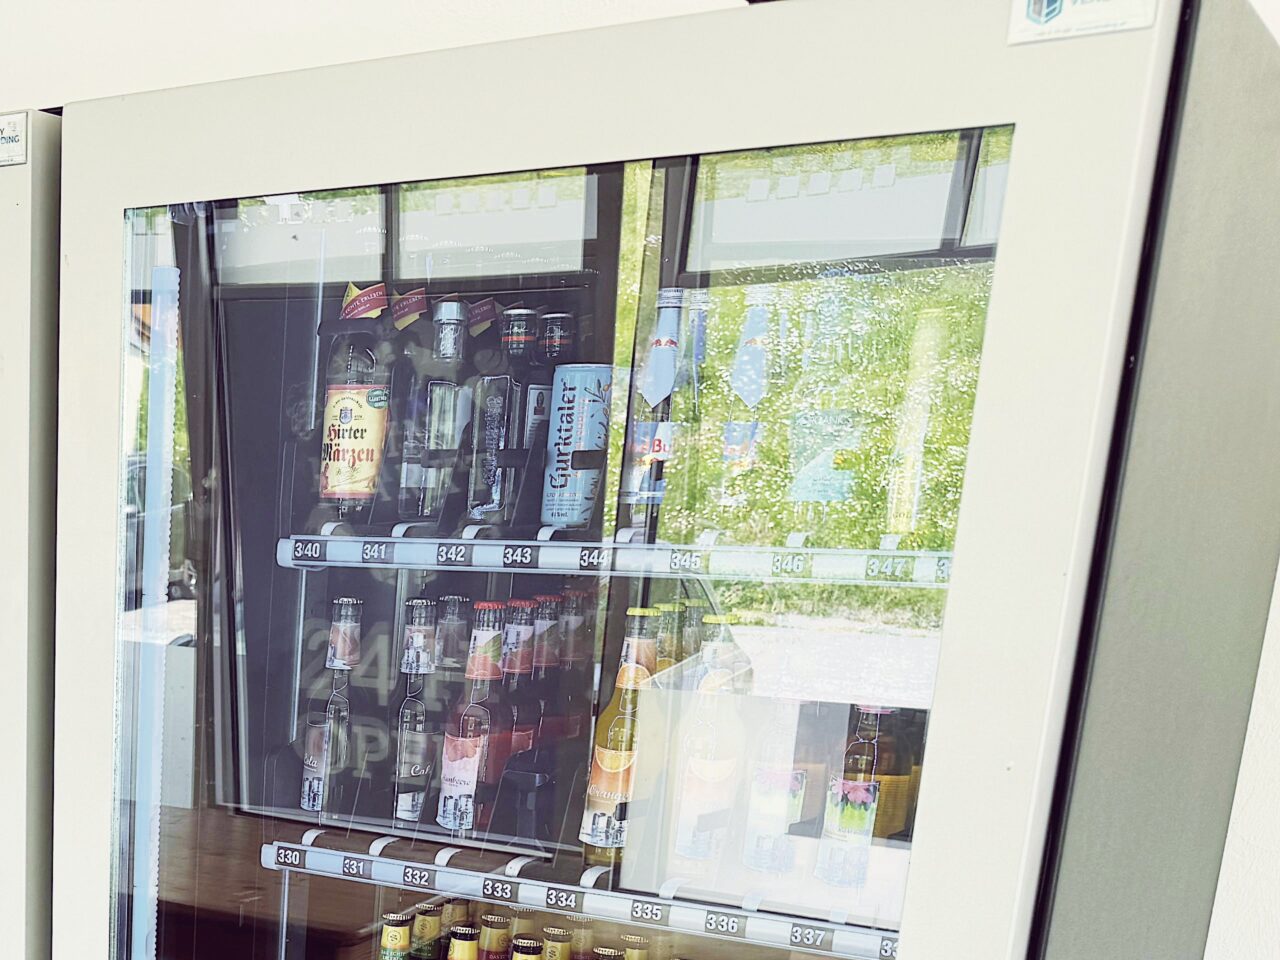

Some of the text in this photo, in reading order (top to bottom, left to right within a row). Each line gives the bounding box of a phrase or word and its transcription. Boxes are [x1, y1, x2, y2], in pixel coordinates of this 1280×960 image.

[327, 423, 367, 441] Hirter
[549, 381, 577, 489] Gurktaler
[322, 442, 374, 468] Märzen
[294, 542, 320, 558] 340
[363, 543, 386, 560] 341
[438, 544, 465, 561] 342
[504, 547, 531, 564] 343
[580, 549, 608, 566] 344
[671, 552, 701, 571] 345
[772, 554, 804, 573] 346
[868, 557, 906, 577] 347
[589, 784, 631, 803] Orange
[278, 849, 300, 865] 330
[344, 859, 364, 875] 331
[404, 868, 429, 885] 332
[484, 881, 511, 898] 333
[547, 889, 576, 909] 334
[632, 902, 662, 921] 335
[706, 913, 738, 933] 336
[791, 926, 825, 946] 337
